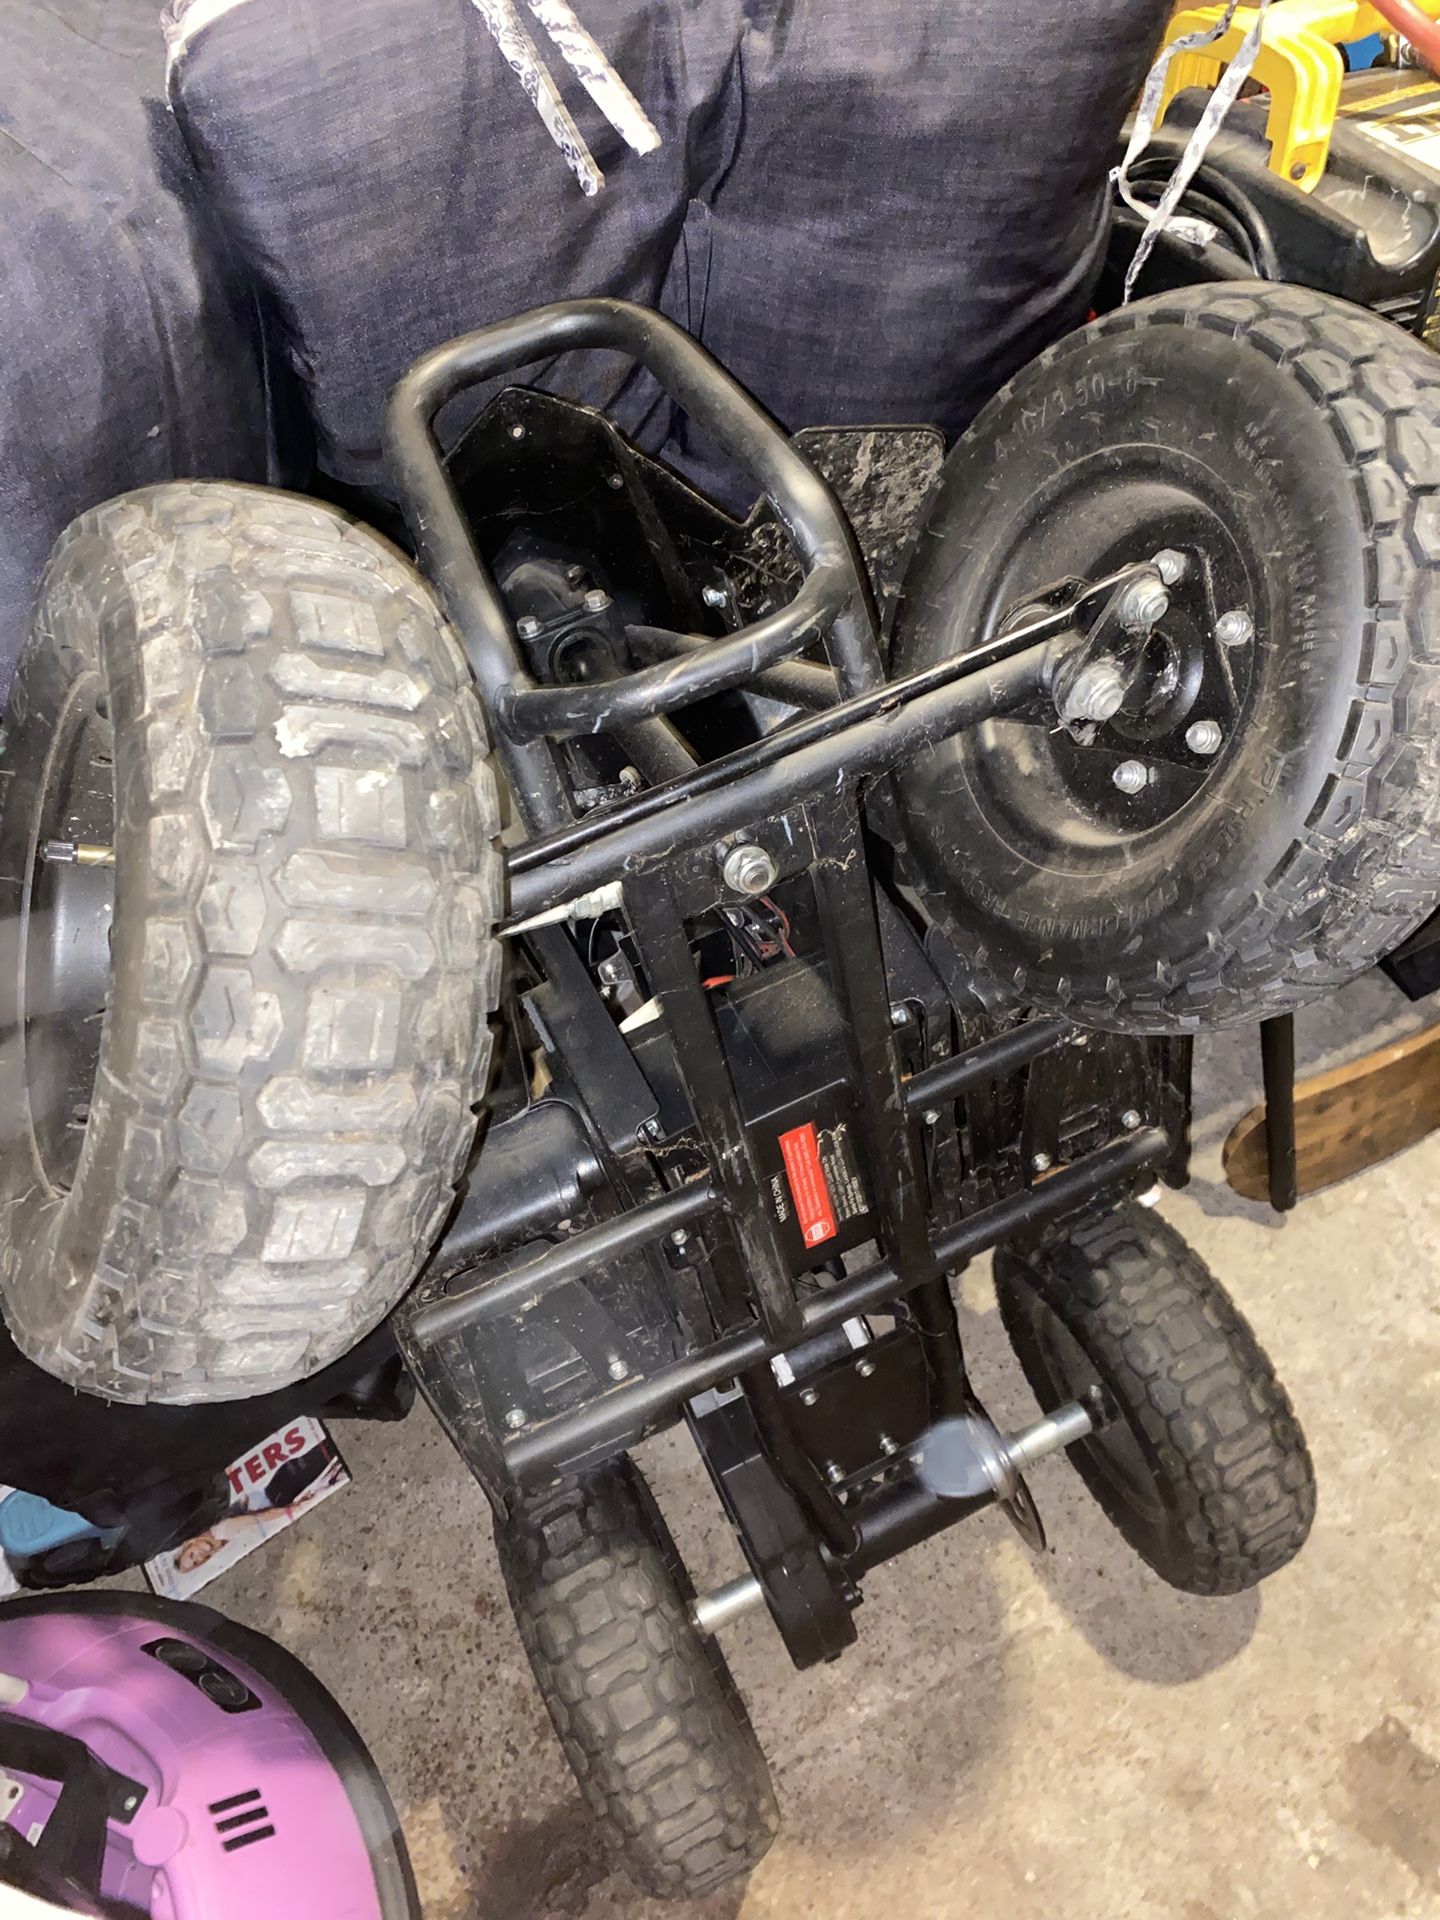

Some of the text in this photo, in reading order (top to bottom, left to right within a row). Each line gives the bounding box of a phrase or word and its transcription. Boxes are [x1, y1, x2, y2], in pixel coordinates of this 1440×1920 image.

[770, 1175, 782, 1197] CHINA
[775, 1202, 787, 1223] MADE
[228, 1426, 306, 1495] TERS
